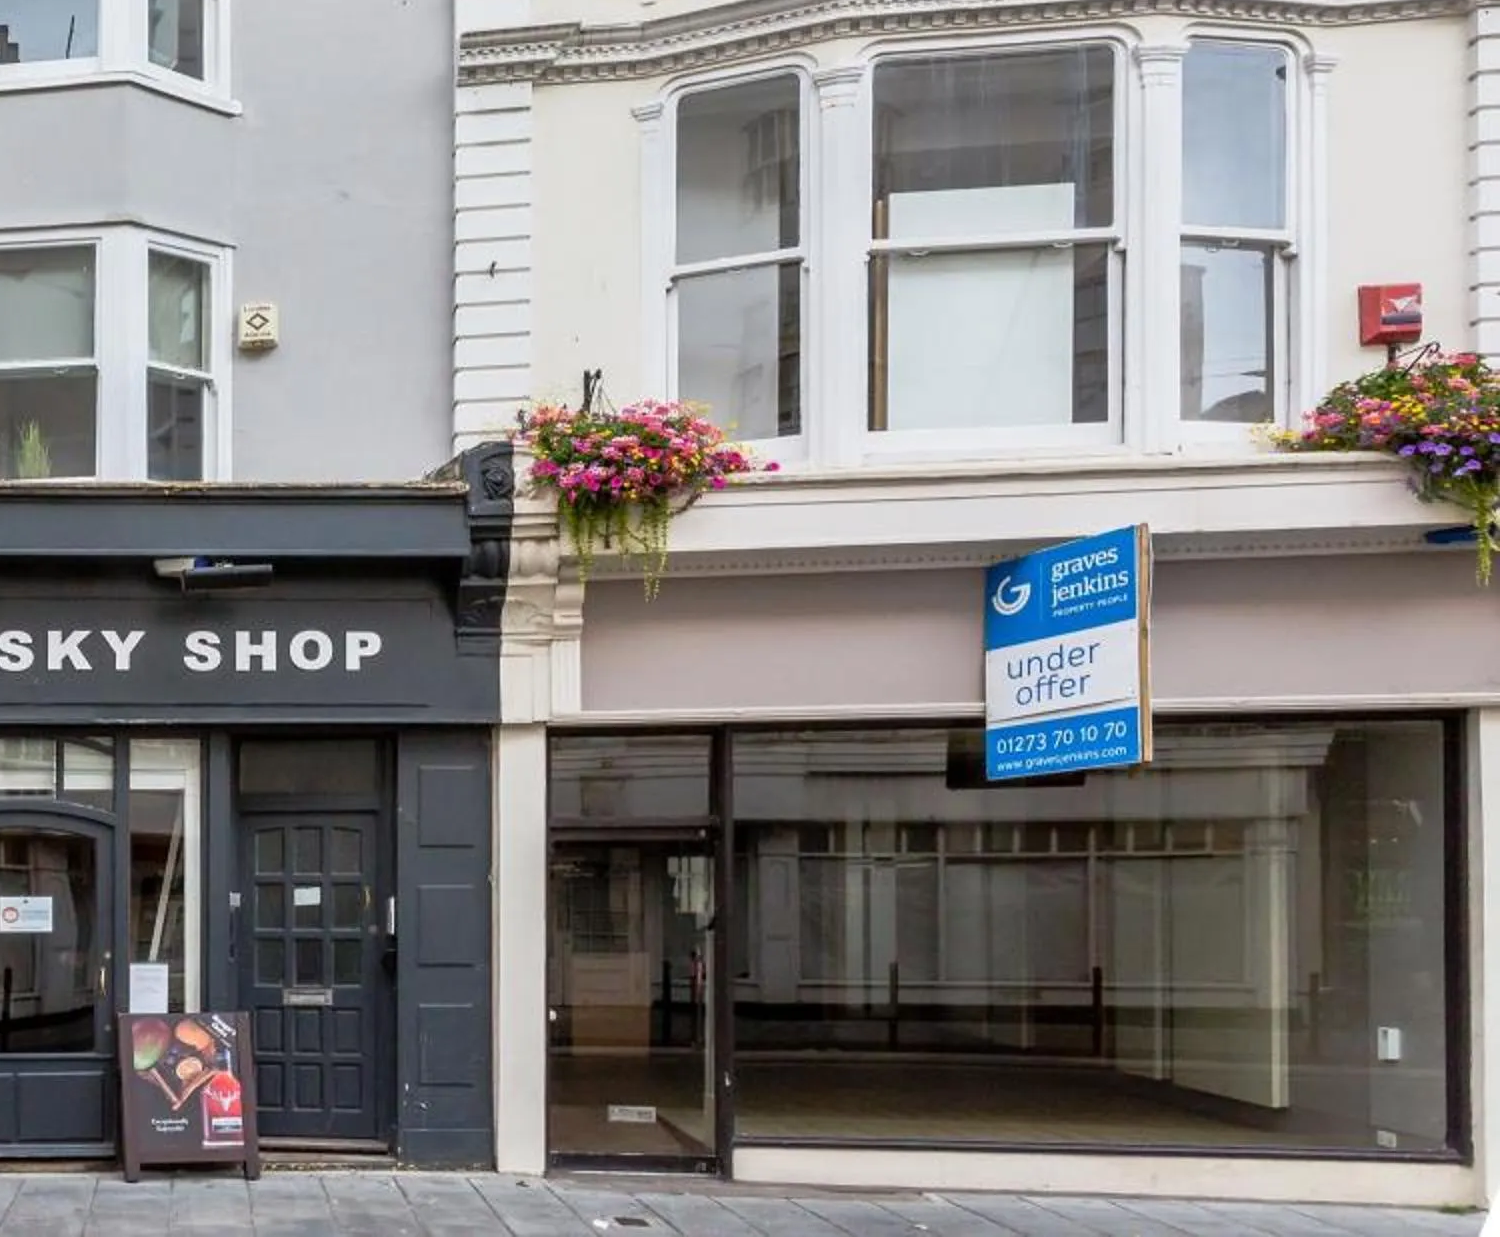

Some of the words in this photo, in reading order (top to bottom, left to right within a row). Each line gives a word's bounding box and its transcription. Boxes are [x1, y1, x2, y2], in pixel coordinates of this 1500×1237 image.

[1051, 547, 1119, 583] graves
[1051, 570, 1130, 608] jenkins
[1052, 602, 1094, 618] PROPERTY
[1097, 592, 1129, 608] PEOPLE
[182, 629, 383, 672] SHOP
[1007, 643, 1101, 680] under
[1016, 673, 1091, 706] offer
[997, 732, 1048, 755] 01273
[1051, 728, 1075, 750] 70
[1080, 724, 1099, 742] 10
[1103, 720, 1128, 743] 70
